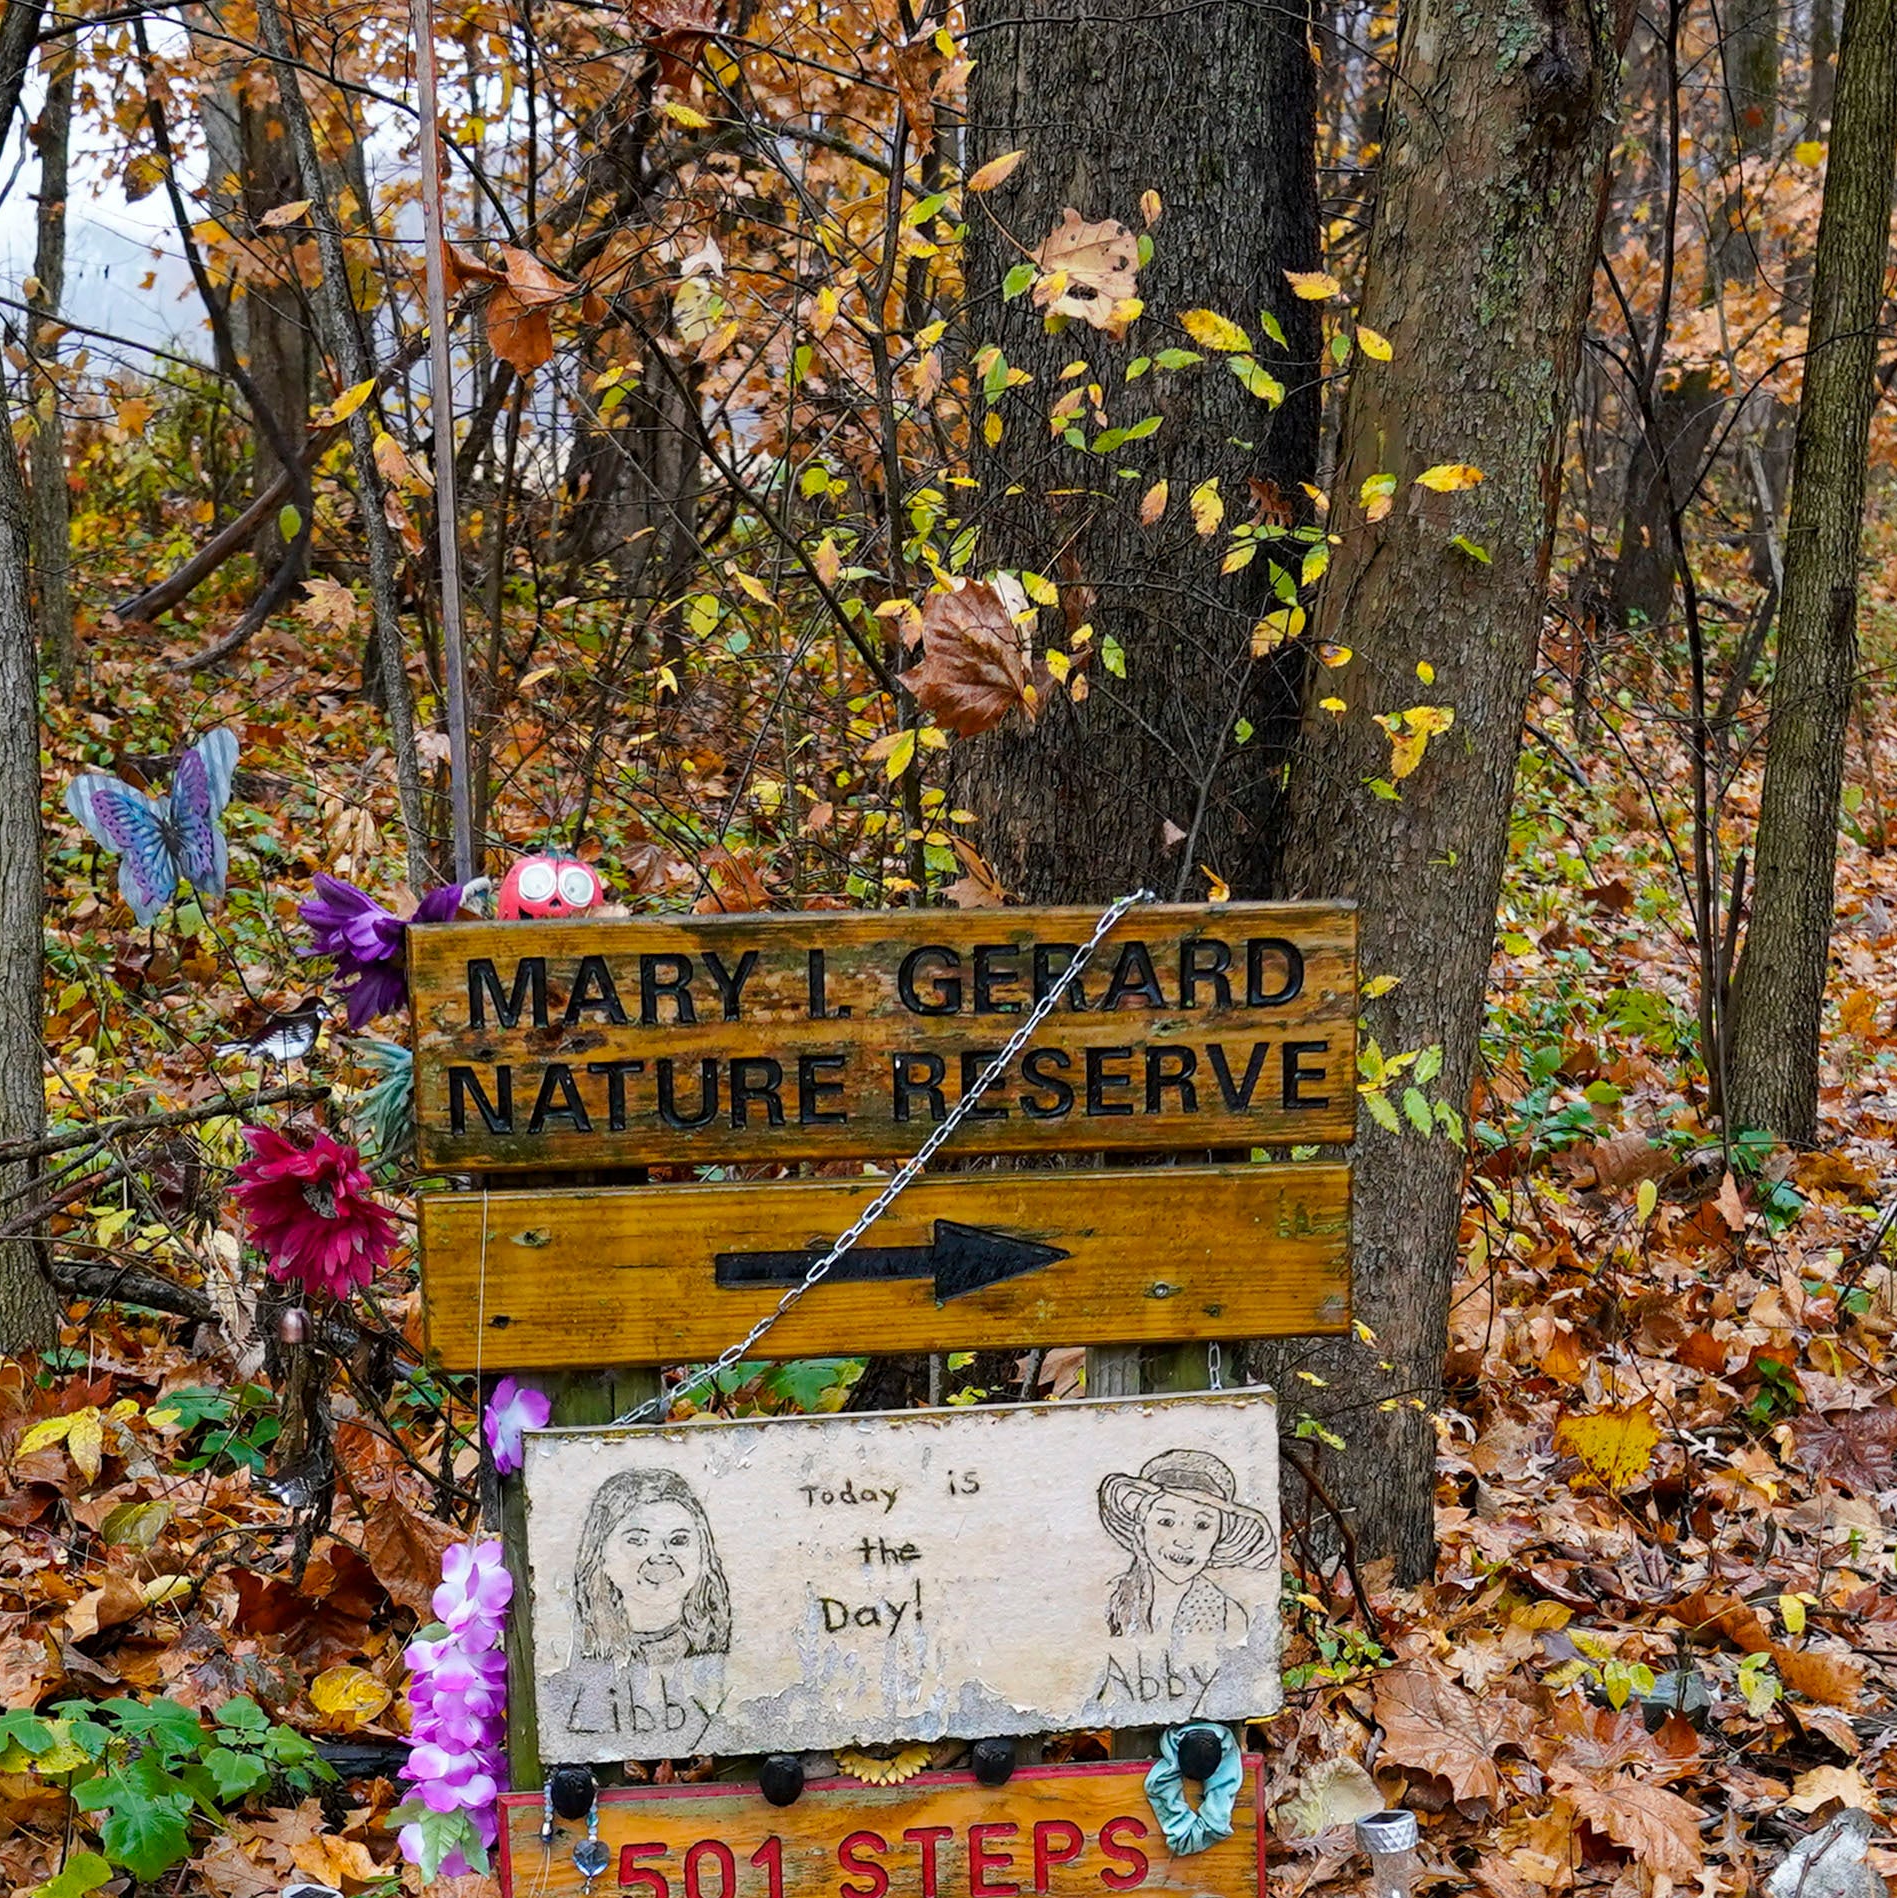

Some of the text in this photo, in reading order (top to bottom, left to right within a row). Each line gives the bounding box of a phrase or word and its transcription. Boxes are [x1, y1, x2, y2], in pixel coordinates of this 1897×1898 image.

[468, 937, 1304, 1030] MARY I. GERARD
[448, 1039, 1330, 1137] NATURE RESERVE
[798, 1470, 980, 1514] Today is
[859, 1538, 921, 1562] the
[821, 1578, 924, 1634] Day!
[565, 1673, 732, 1751] Libby
[1099, 1650, 1220, 1722] Abby
